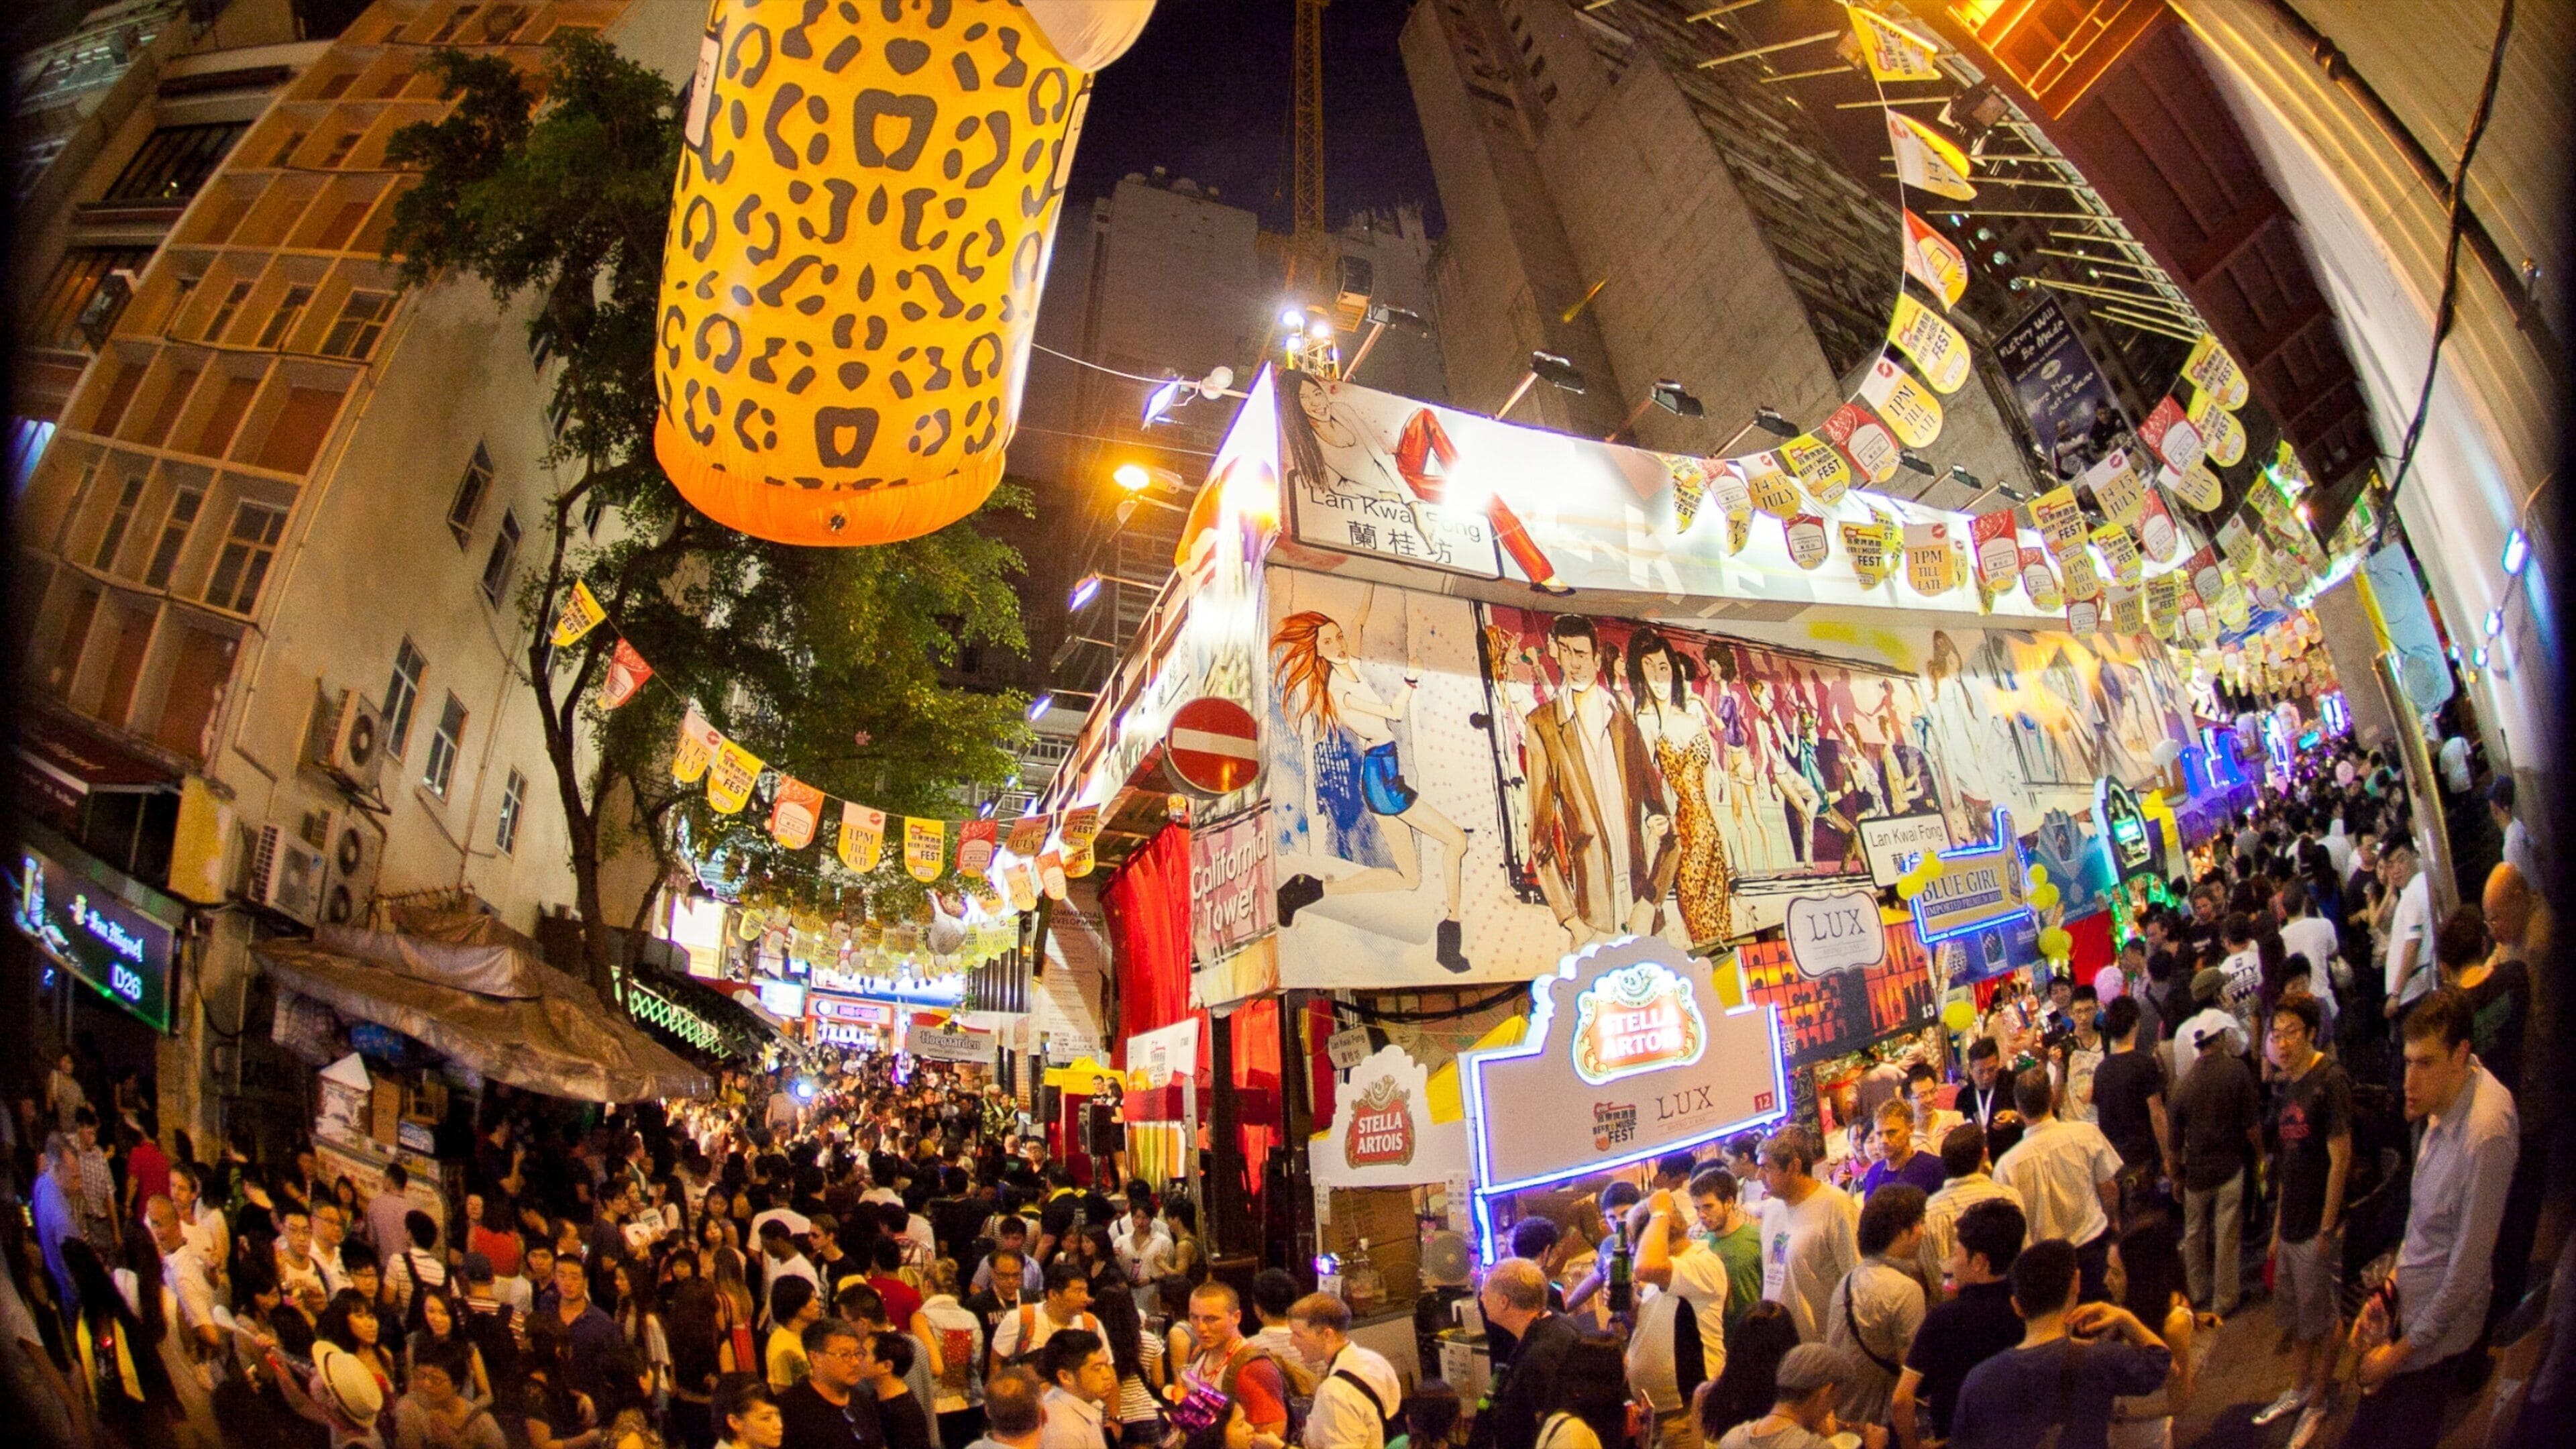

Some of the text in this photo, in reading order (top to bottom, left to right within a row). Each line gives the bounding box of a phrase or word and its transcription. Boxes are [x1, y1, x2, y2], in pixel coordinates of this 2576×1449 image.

[1932, 327, 1952, 361] FEST
[2218, 360, 2235, 386] FEST
[1889, 384, 1917, 417] 1PM
[1817, 459, 1842, 481] FEST
[1309, 487, 1354, 511] Lan
[1359, 494, 1413, 524] Kwa
[1761, 489, 1795, 511] JULY
[2109, 490, 2139, 518] JULY
[2058, 523, 2083, 540] FEST
[1858, 557, 1882, 567] FEST
[1913, 550, 1943, 564] 1PM
[2067, 558, 2090, 575] 1PM
[2117, 550, 2137, 566] FEST
[2115, 600, 2137, 614] 1PM
[2159, 598, 2176, 609] FEST
[723, 778, 748, 798] FEST
[848, 828, 874, 845] 1PM
[1073, 824, 1094, 835] FEST
[1869, 824, 1943, 848] Lan Kwai Fong
[1010, 837, 1036, 849] JULY
[920, 850, 940, 861] FEST
[1191, 824, 1268, 901] California
[1922, 868, 2000, 903] BLUE GIRL
[1052, 908, 1103, 920] OMMERCIAL
[1203, 883, 1256, 935] Tower
[1925, 899, 1963, 917] IMPORTED
[1051, 916, 1103, 927] EVELOPMENT
[1807, 908, 1866, 943] LUX
[112, 963, 143, 1000] D26
[1921, 1003, 1935, 1019] 13
[920, 1030, 982, 1051] Hoegaarden
[1655, 1085, 1714, 1121] LUX
[1757, 1096, 1772, 1110] 12
[1358, 1111, 1403, 1135] STELLA
[1356, 1132, 1403, 1155] ARTOIS
[1609, 1128, 1635, 1144] FEST
